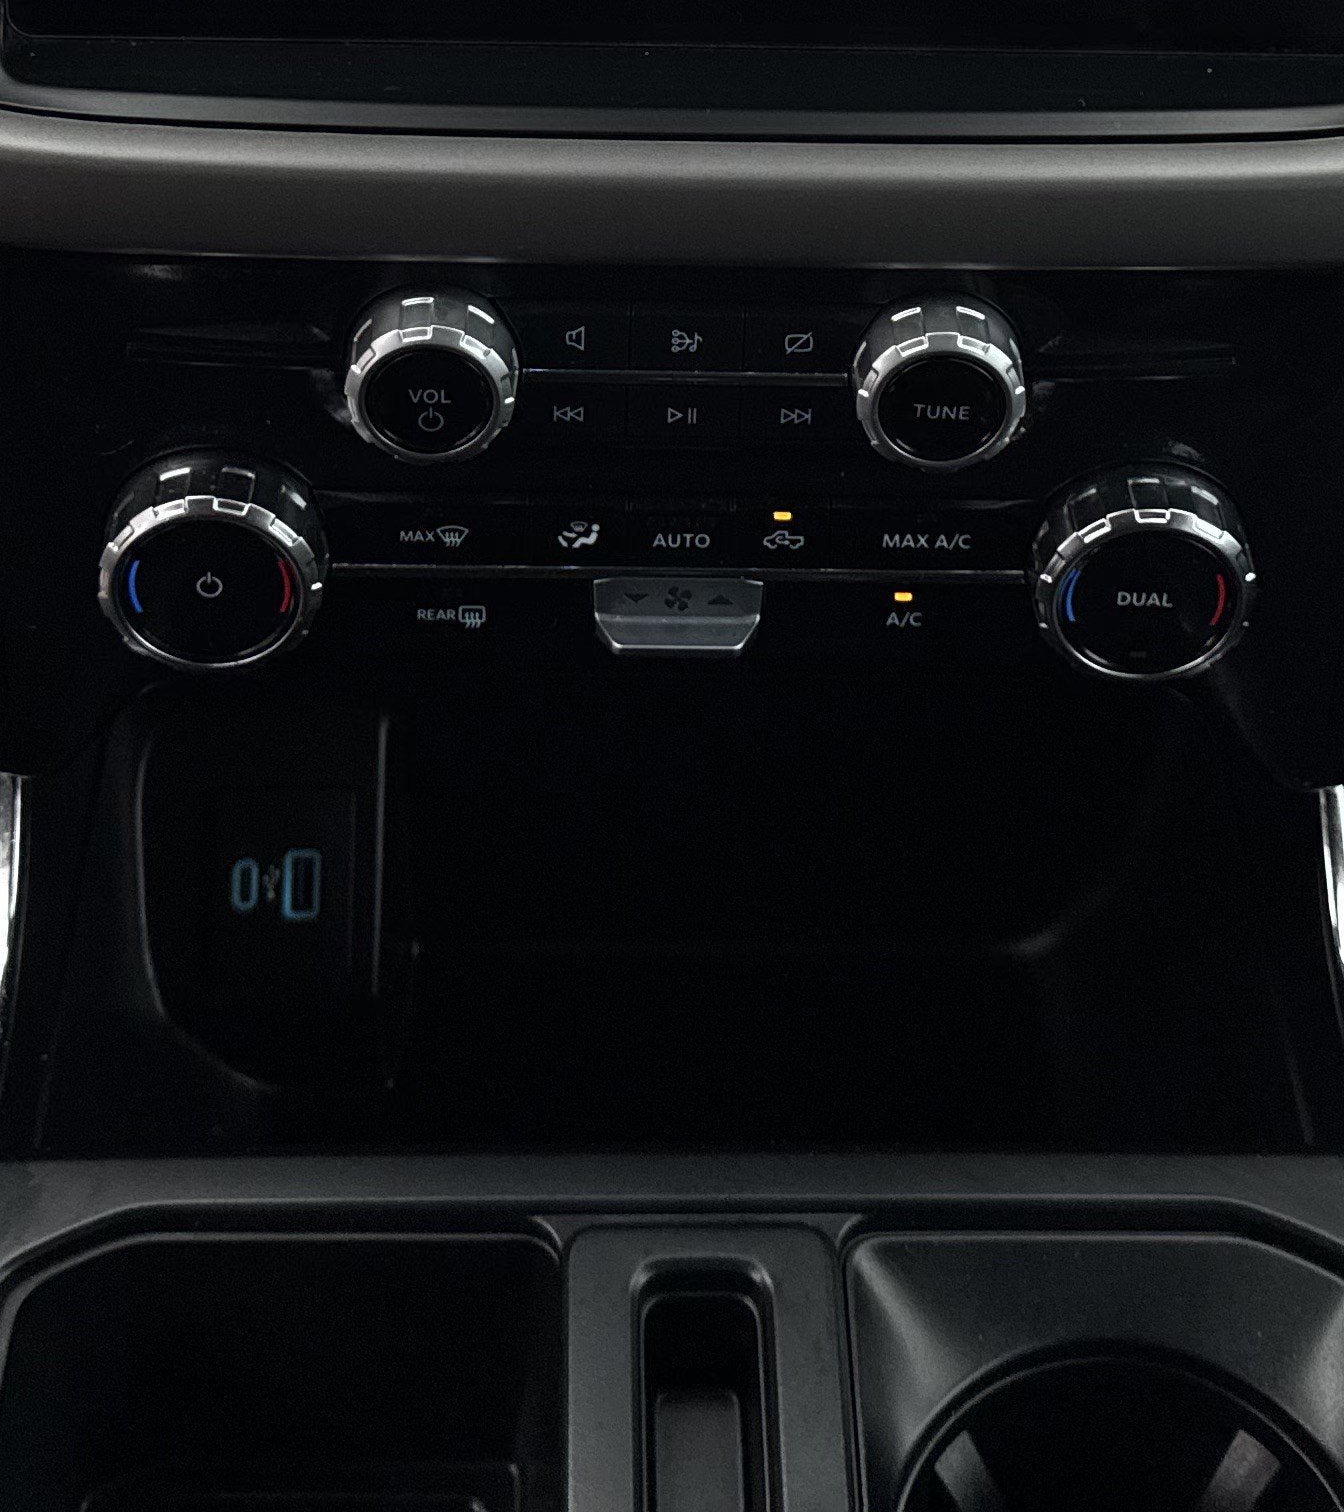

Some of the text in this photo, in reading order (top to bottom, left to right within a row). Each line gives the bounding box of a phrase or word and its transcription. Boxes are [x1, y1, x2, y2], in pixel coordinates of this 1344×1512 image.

[408, 388, 452, 405] VOL
[912, 402, 971, 422] TUNE
[399, 529, 436, 543] MAX
[652, 533, 711, 549] AUTO
[882, 533, 973, 550] MAX A/C
[1116, 590, 1173, 608] DUAL
[416, 608, 457, 621] REAR
[886, 611, 923, 628] A/C
